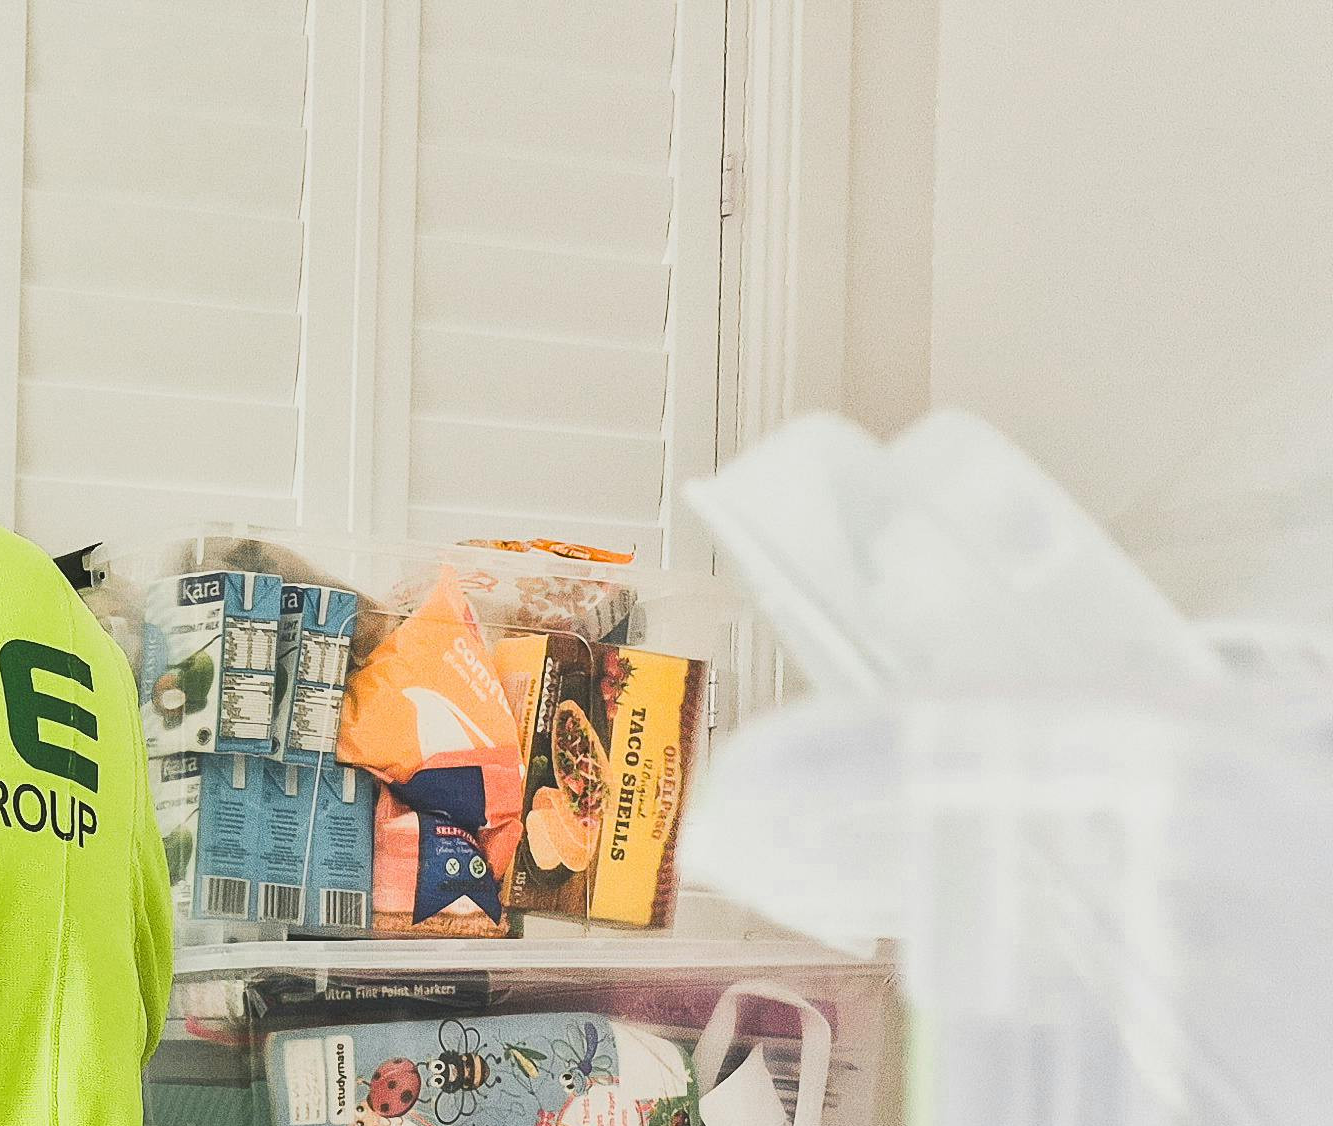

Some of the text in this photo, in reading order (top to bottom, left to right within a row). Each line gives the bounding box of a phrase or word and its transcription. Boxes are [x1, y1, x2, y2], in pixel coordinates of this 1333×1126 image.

[181, 579, 220, 603] kara
[282, 591, 299, 609] ra
[610, 707, 647, 862] TACO SHELLS
[356, 987, 378, 1000] Fine
[381, 985, 410, 998] Point
[413, 984, 456, 996] Markers
[335, 1043, 347, 1107] studymate
